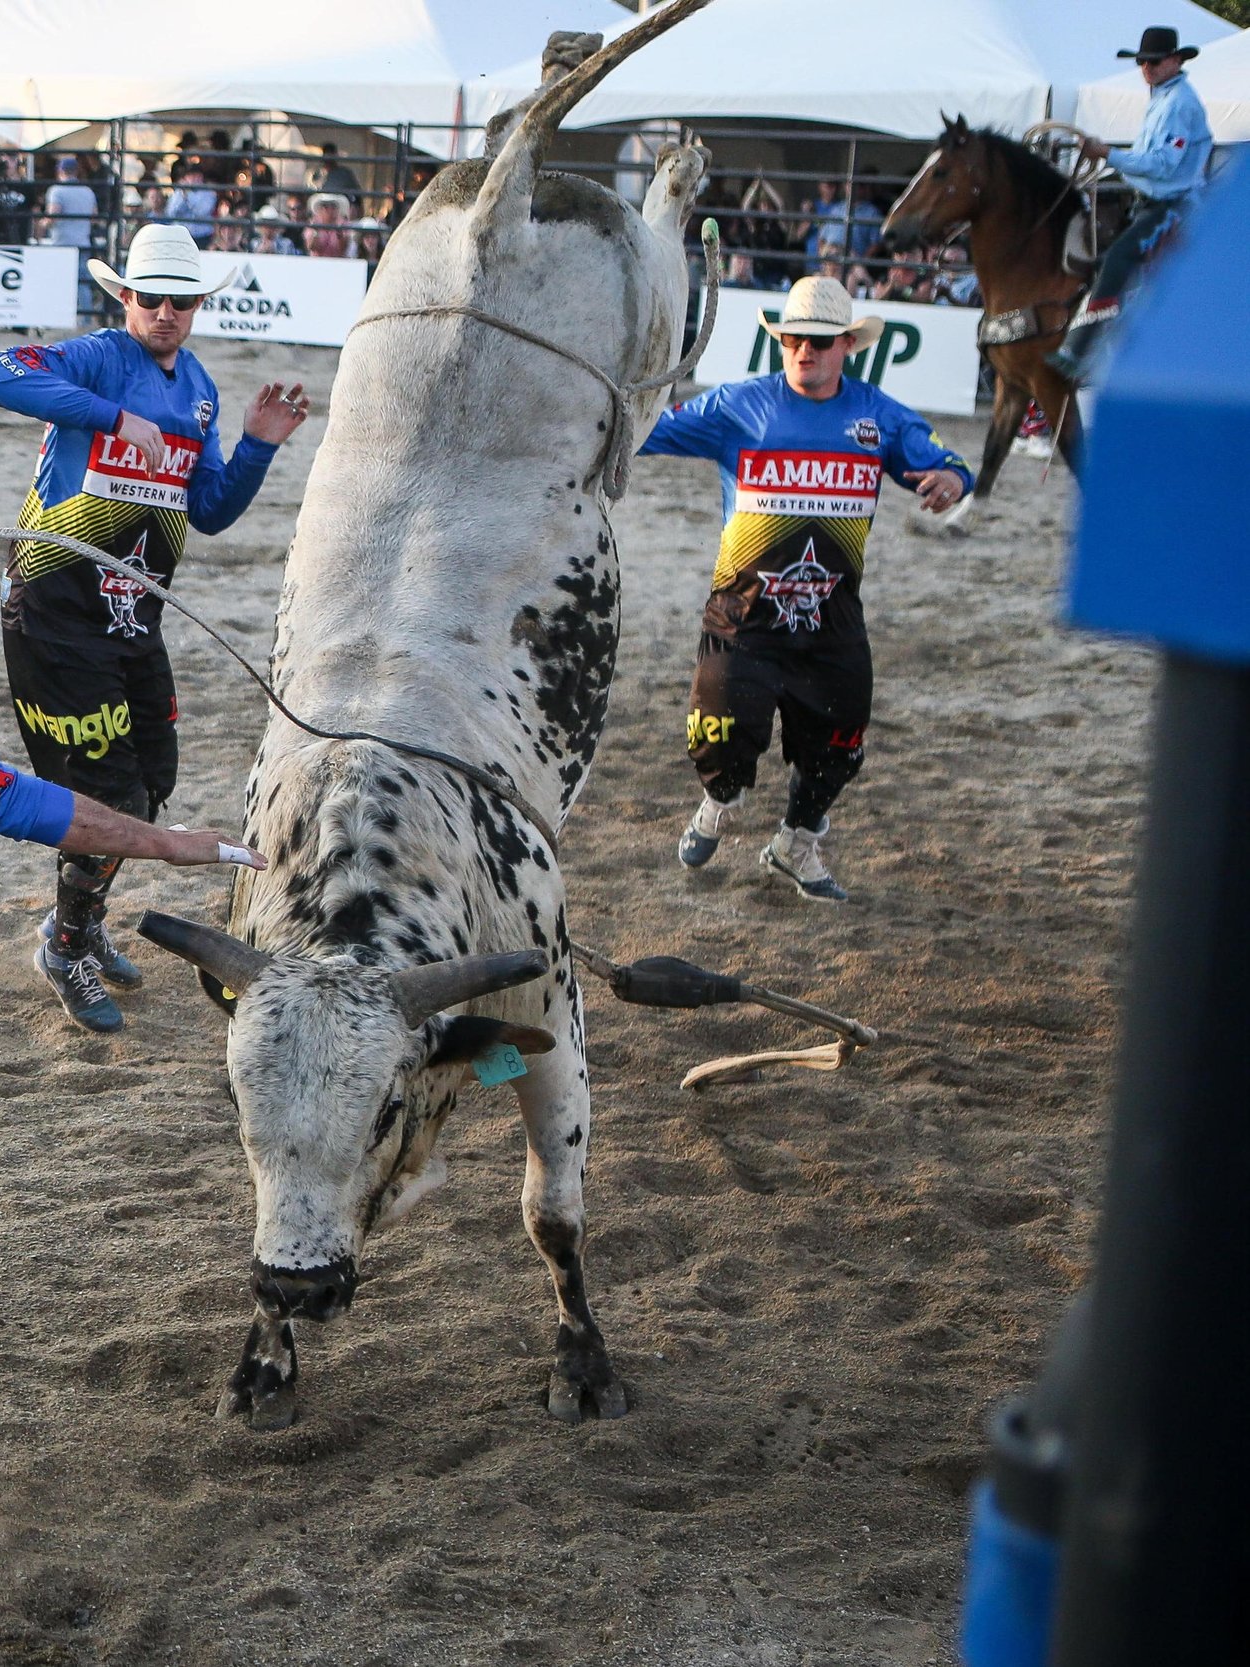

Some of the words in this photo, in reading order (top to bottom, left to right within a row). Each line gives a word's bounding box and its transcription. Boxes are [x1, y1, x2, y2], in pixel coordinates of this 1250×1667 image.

[201, 295, 293, 318] BRODA
[742, 459, 880, 490] LAMMLE'S
[110, 481, 166, 501] WESTERN
[757, 498, 825, 511] WESTERN
[831, 500, 864, 513] WEAR
